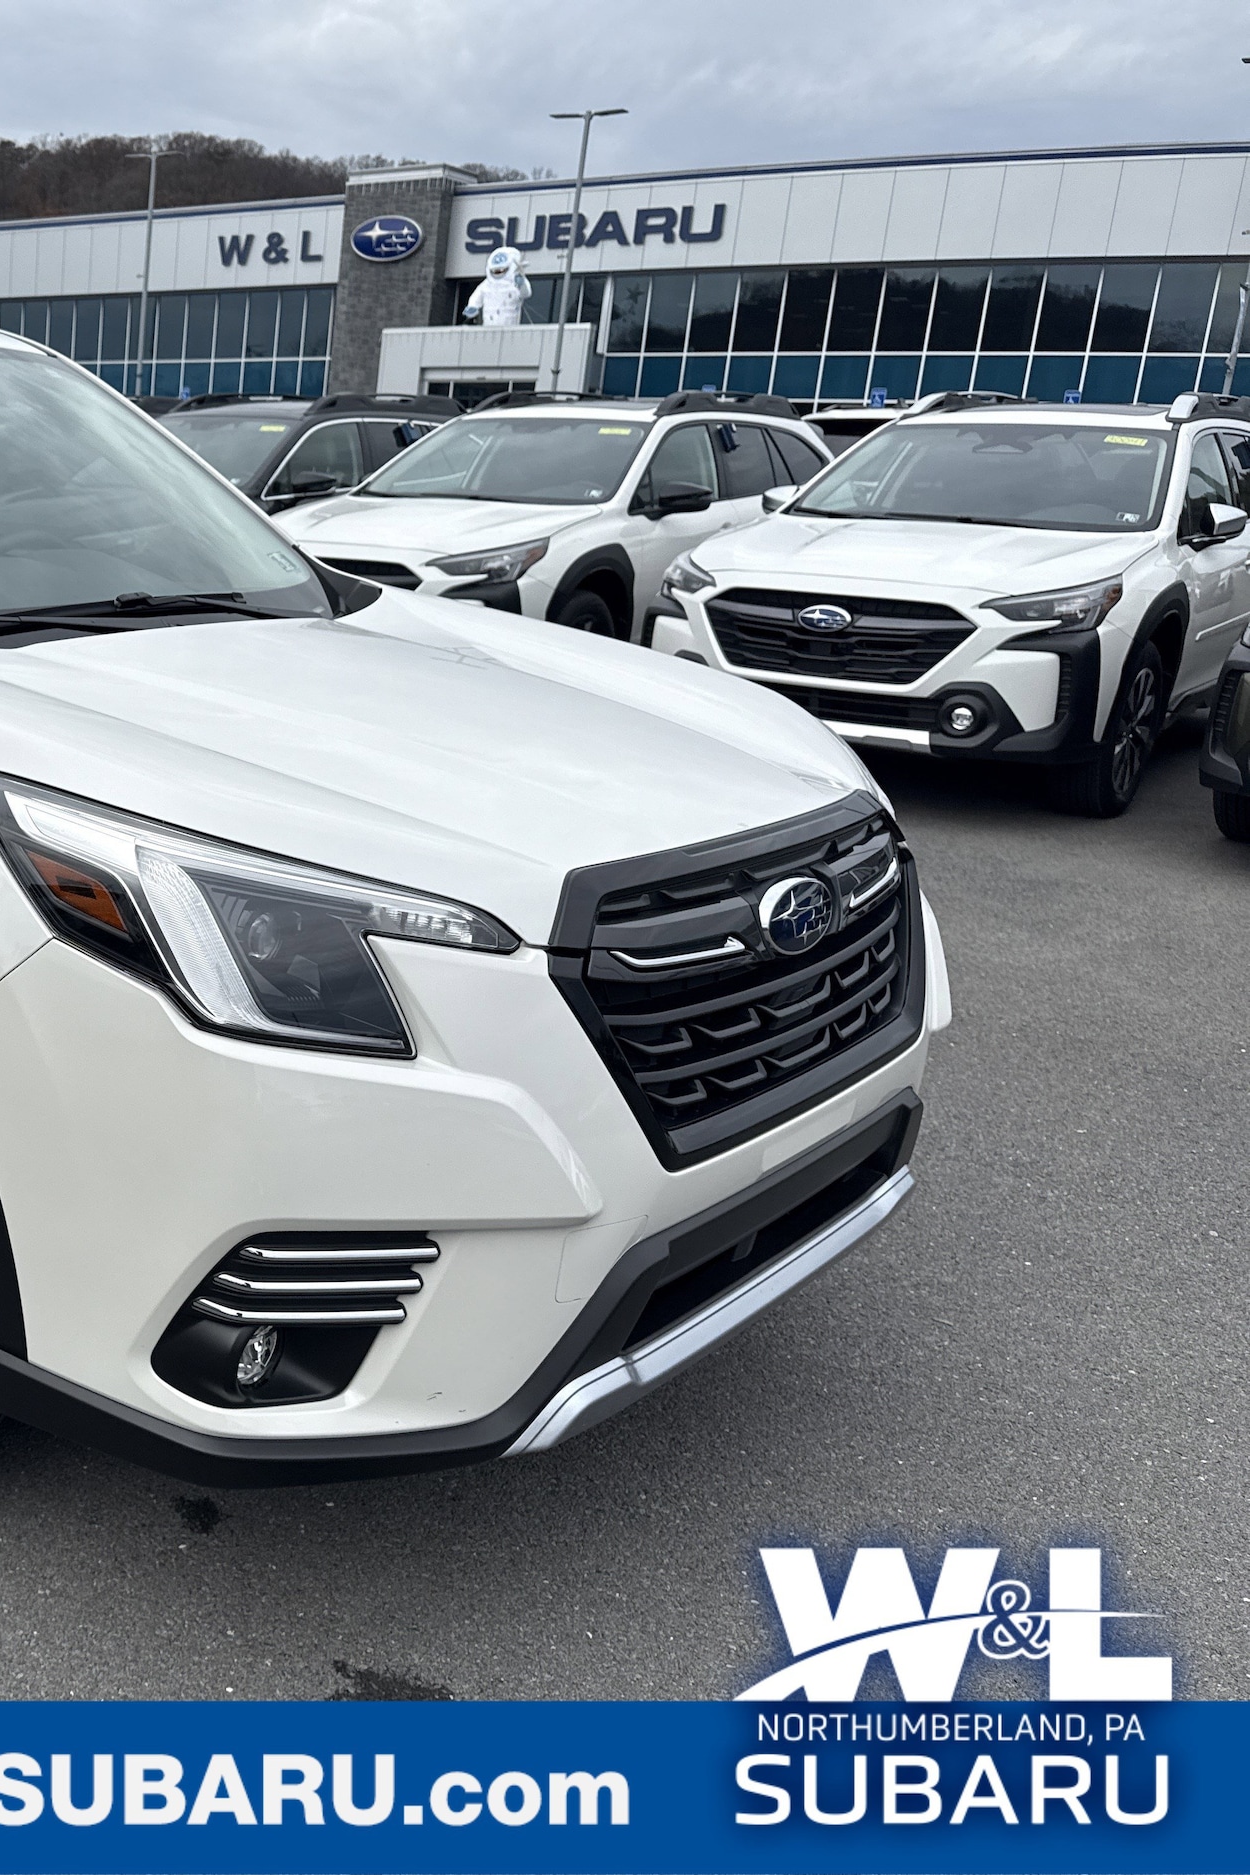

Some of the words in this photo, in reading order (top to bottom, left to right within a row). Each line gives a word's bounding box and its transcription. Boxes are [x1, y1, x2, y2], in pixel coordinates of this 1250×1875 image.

[219, 233, 254, 267] W
[262, 232, 290, 263] &
[301, 230, 323, 262] L
[465, 203, 727, 254] SUBARU
